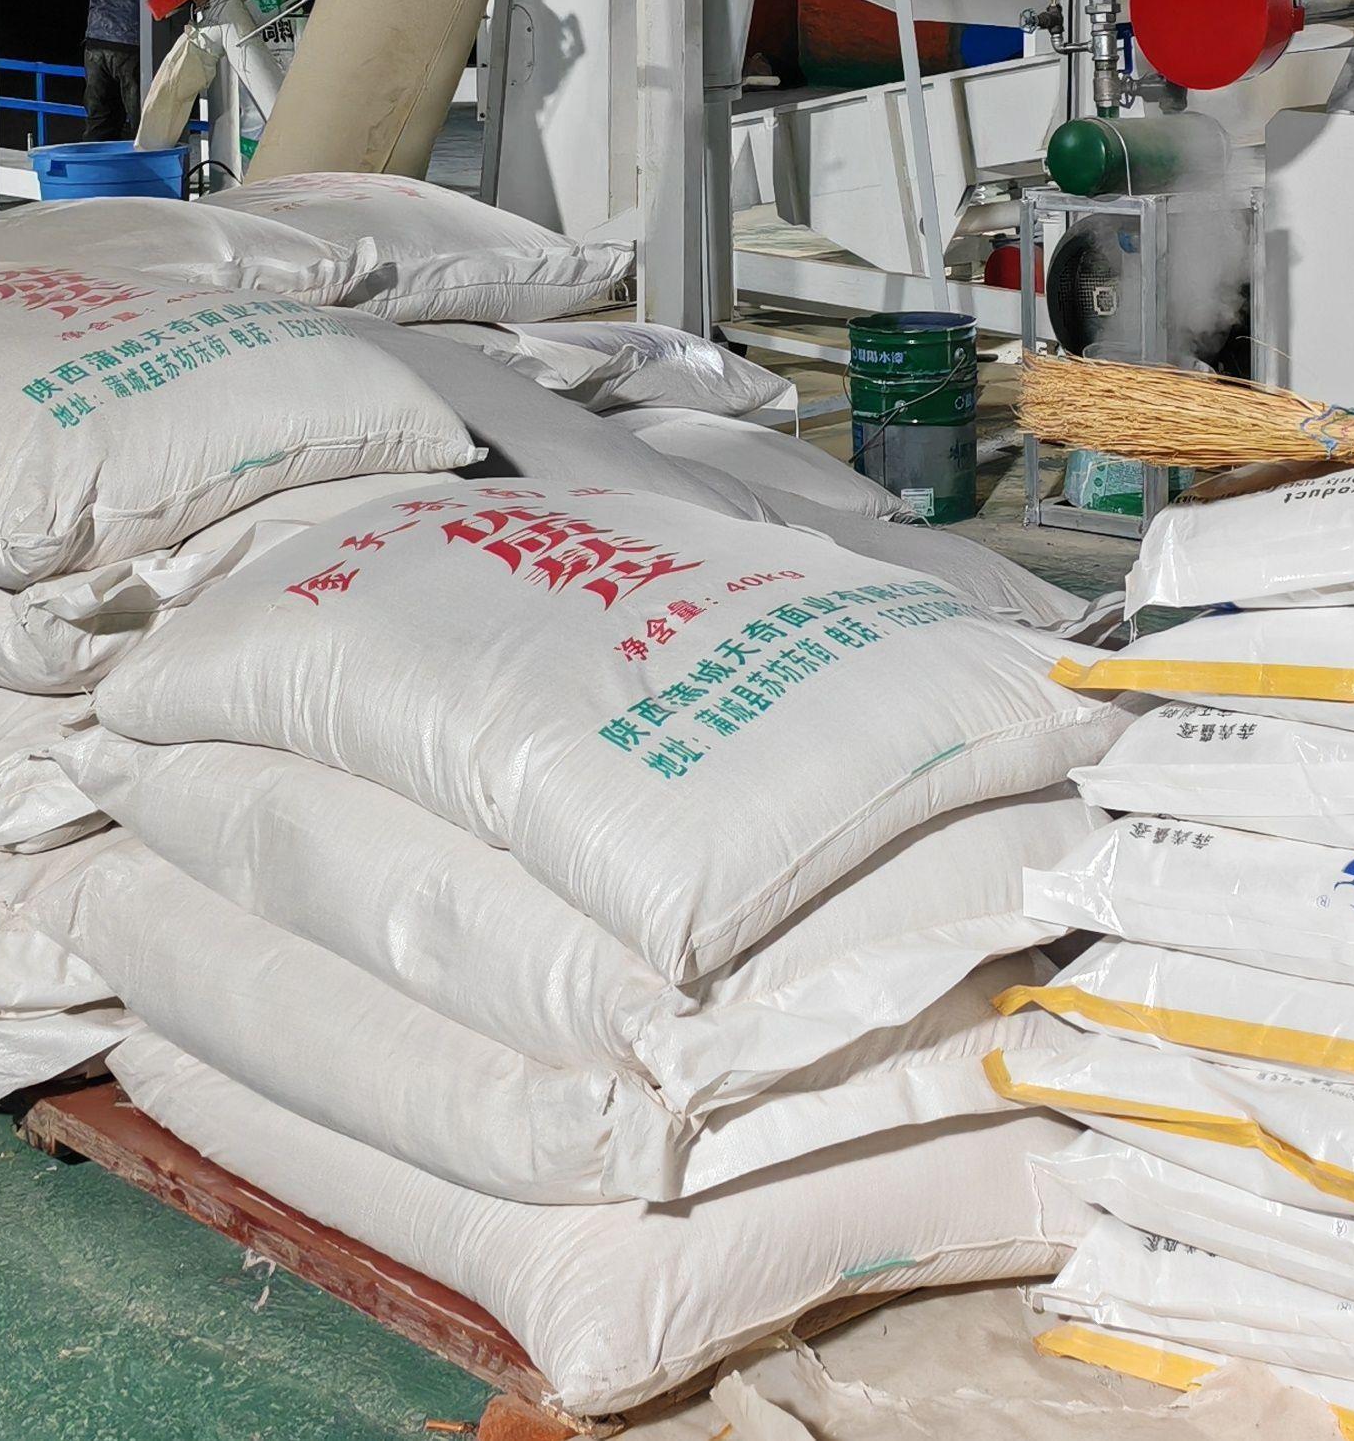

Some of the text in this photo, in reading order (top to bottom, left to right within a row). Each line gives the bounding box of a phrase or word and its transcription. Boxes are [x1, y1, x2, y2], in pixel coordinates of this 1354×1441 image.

[22, 299, 318, 404] 陕西蒲城天奇面业有限
[598, 580, 957, 752] 陕西蒲城天奇面业有限公司
